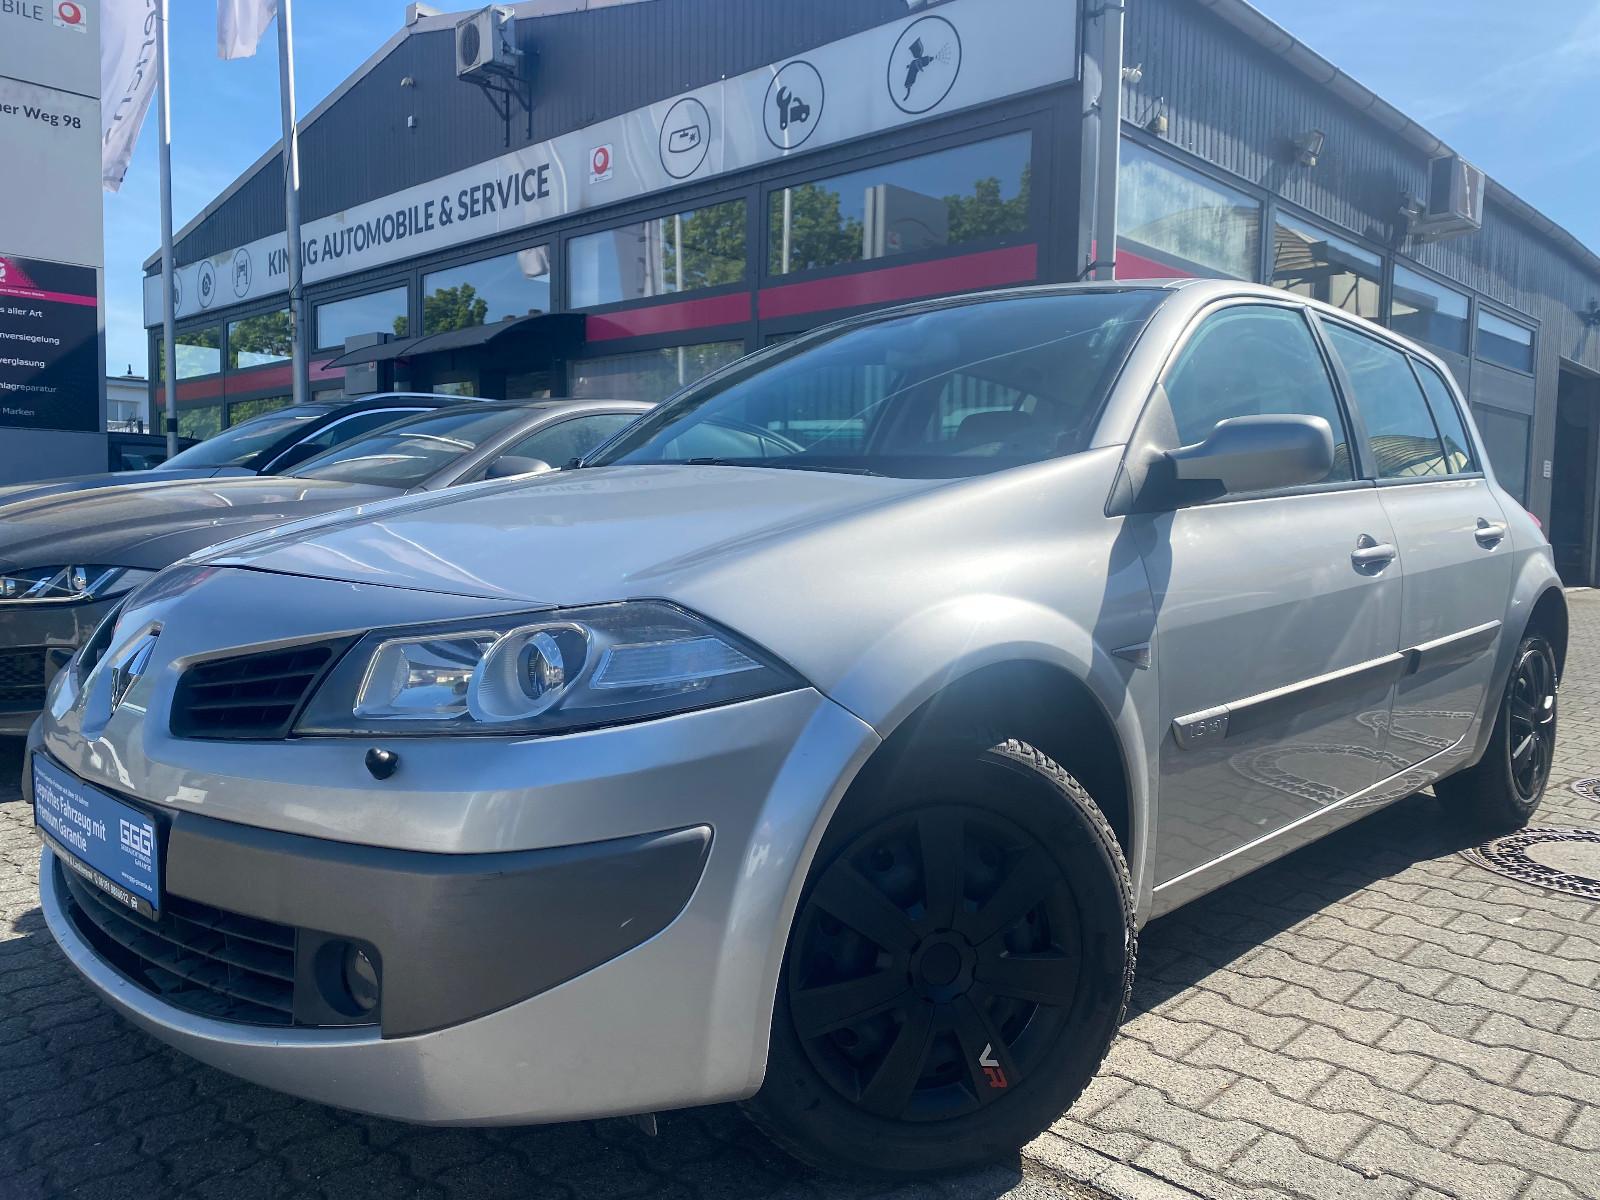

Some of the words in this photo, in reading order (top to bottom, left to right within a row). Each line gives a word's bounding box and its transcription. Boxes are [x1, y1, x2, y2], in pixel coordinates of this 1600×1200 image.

[22, 104, 60, 127] Weg
[62, 113, 82, 129] 98
[321, 199, 436, 263] AUTOMOBILE
[438, 195, 454, 227] &
[457, 162, 551, 221] SERVICE
[7, 307, 27, 316] aller
[29, 309, 44, 318] Art
[2, 407, 36, 417] Marken
[59, 817, 87, 852] Garantie
[60, 795, 92, 837] Fahrzeug
[92, 819, 107, 842] mit
[119, 818, 153, 857] GGG
